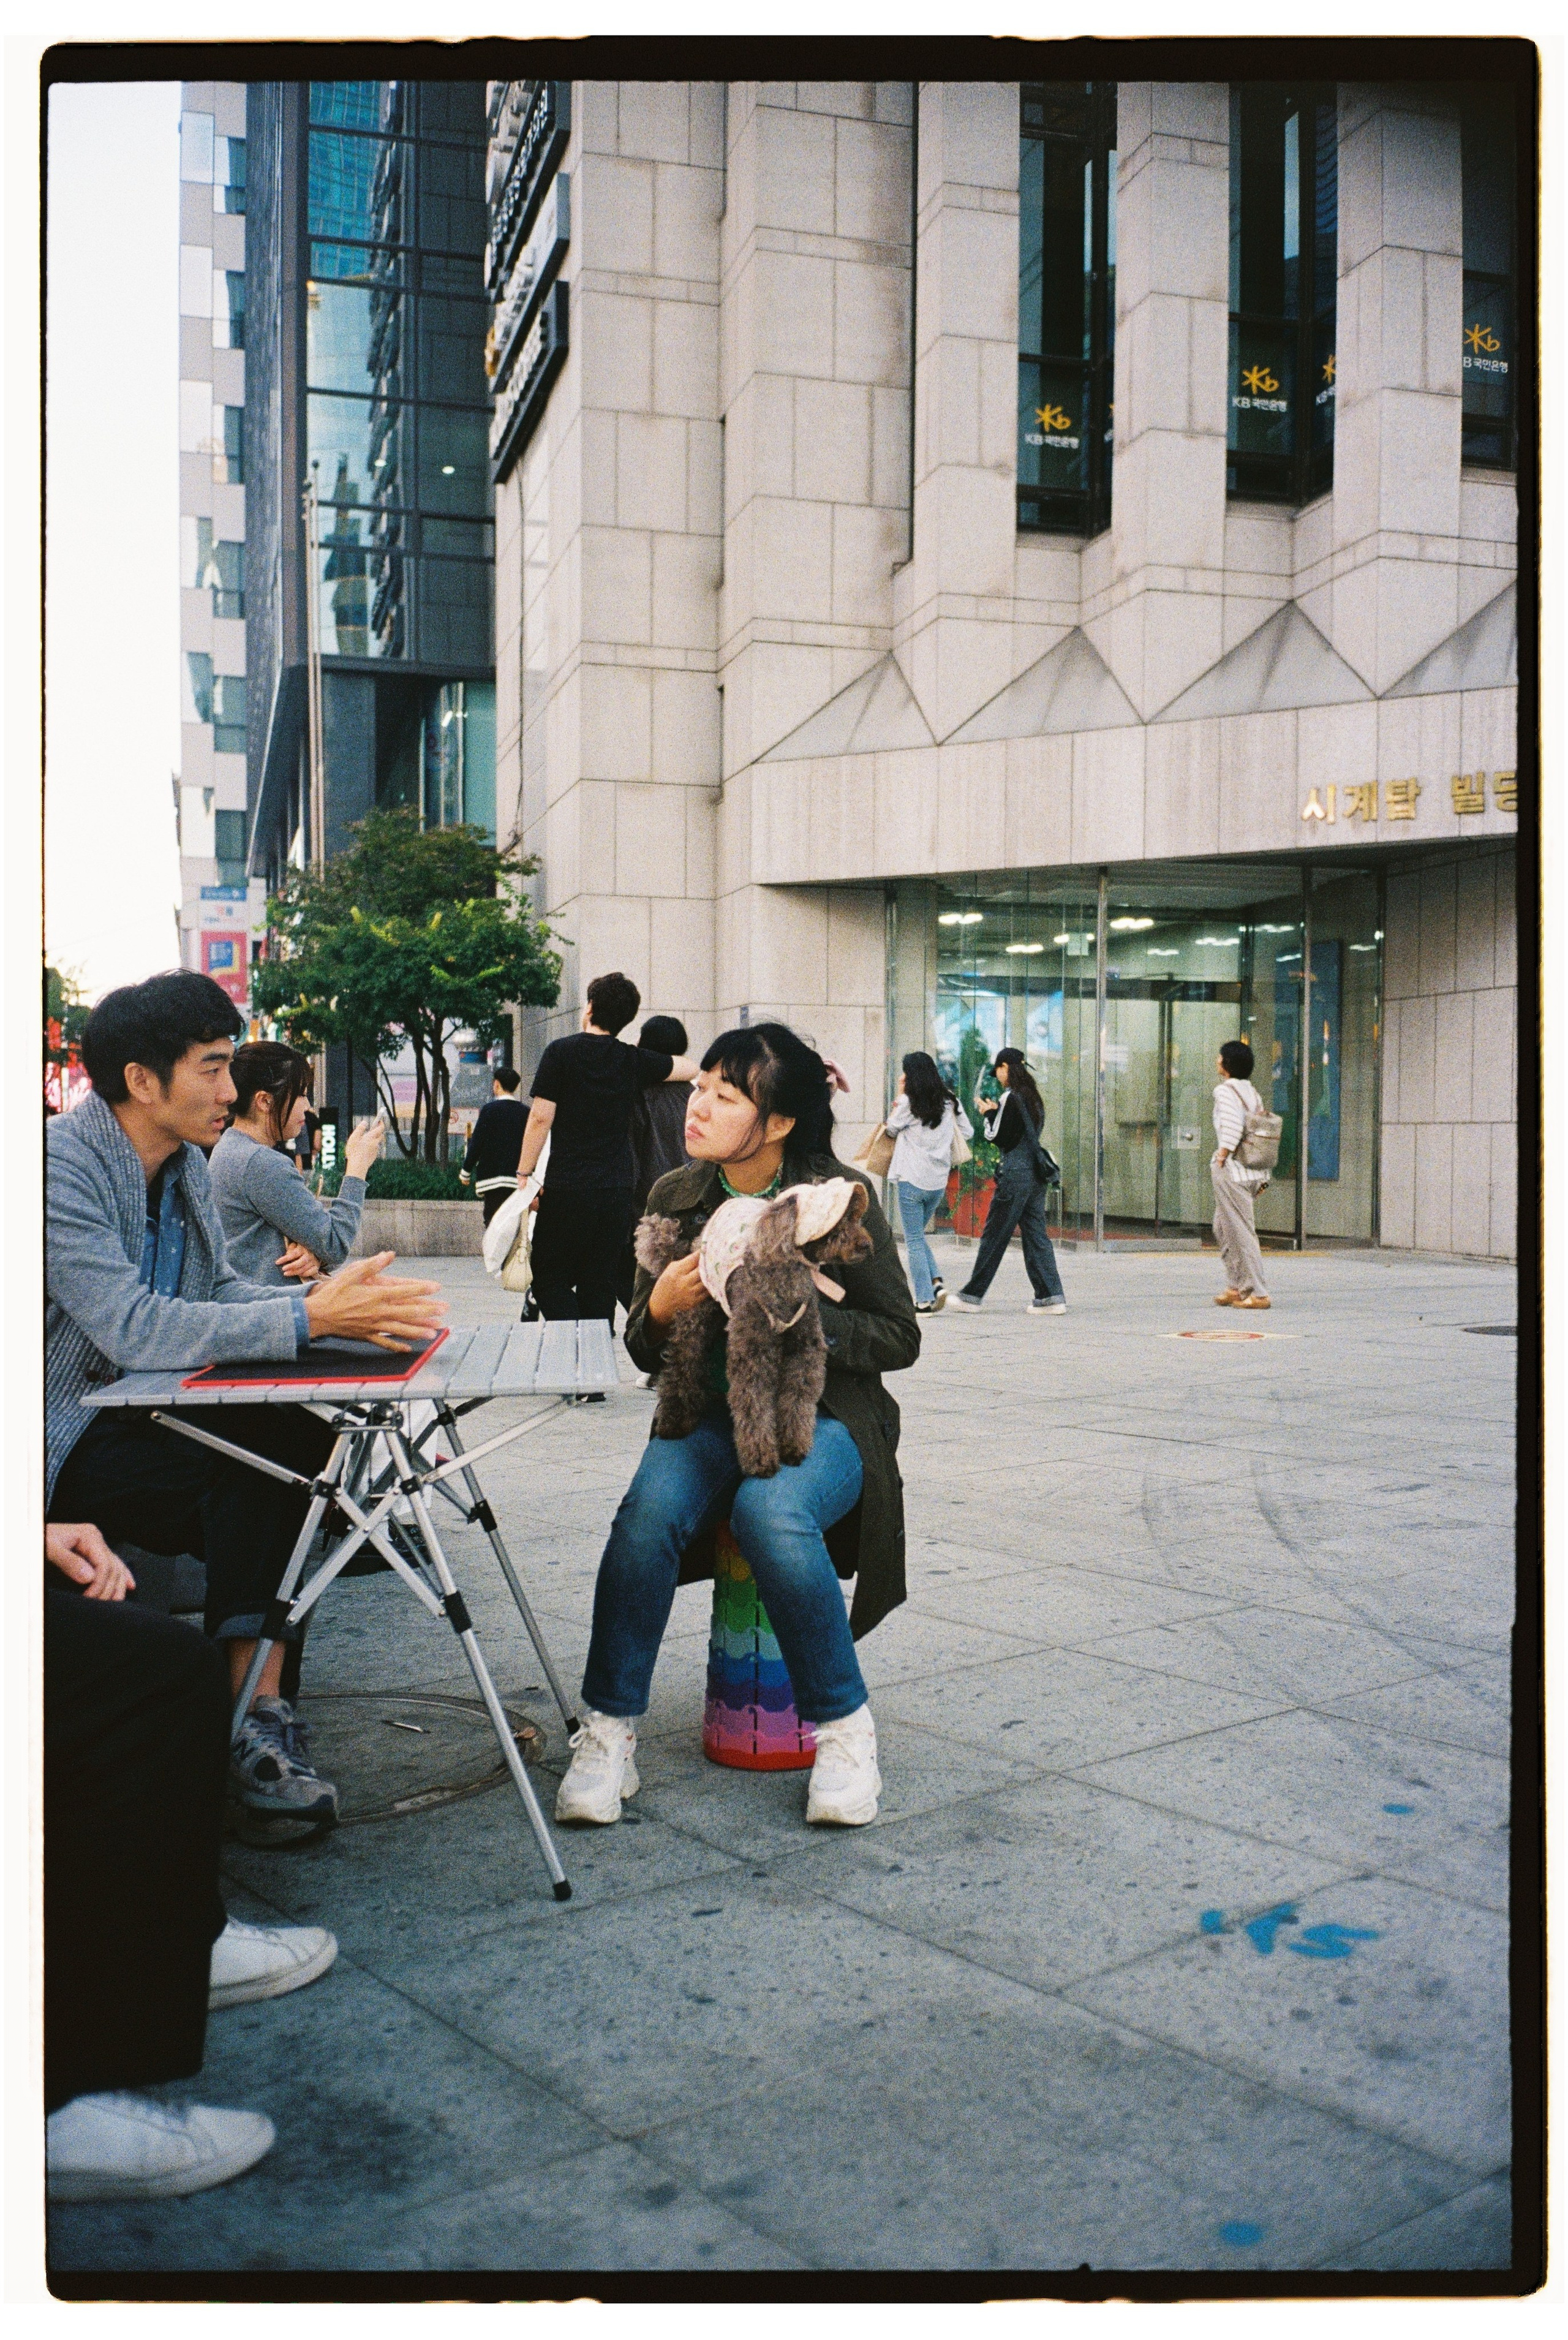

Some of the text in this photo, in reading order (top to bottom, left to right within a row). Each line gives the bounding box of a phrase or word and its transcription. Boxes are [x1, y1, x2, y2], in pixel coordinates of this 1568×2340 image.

[1463, 357, 1509, 373] B 국민은행
[1232, 396, 1251, 409] KB
[1301, 776, 1422, 825] 시계탑
